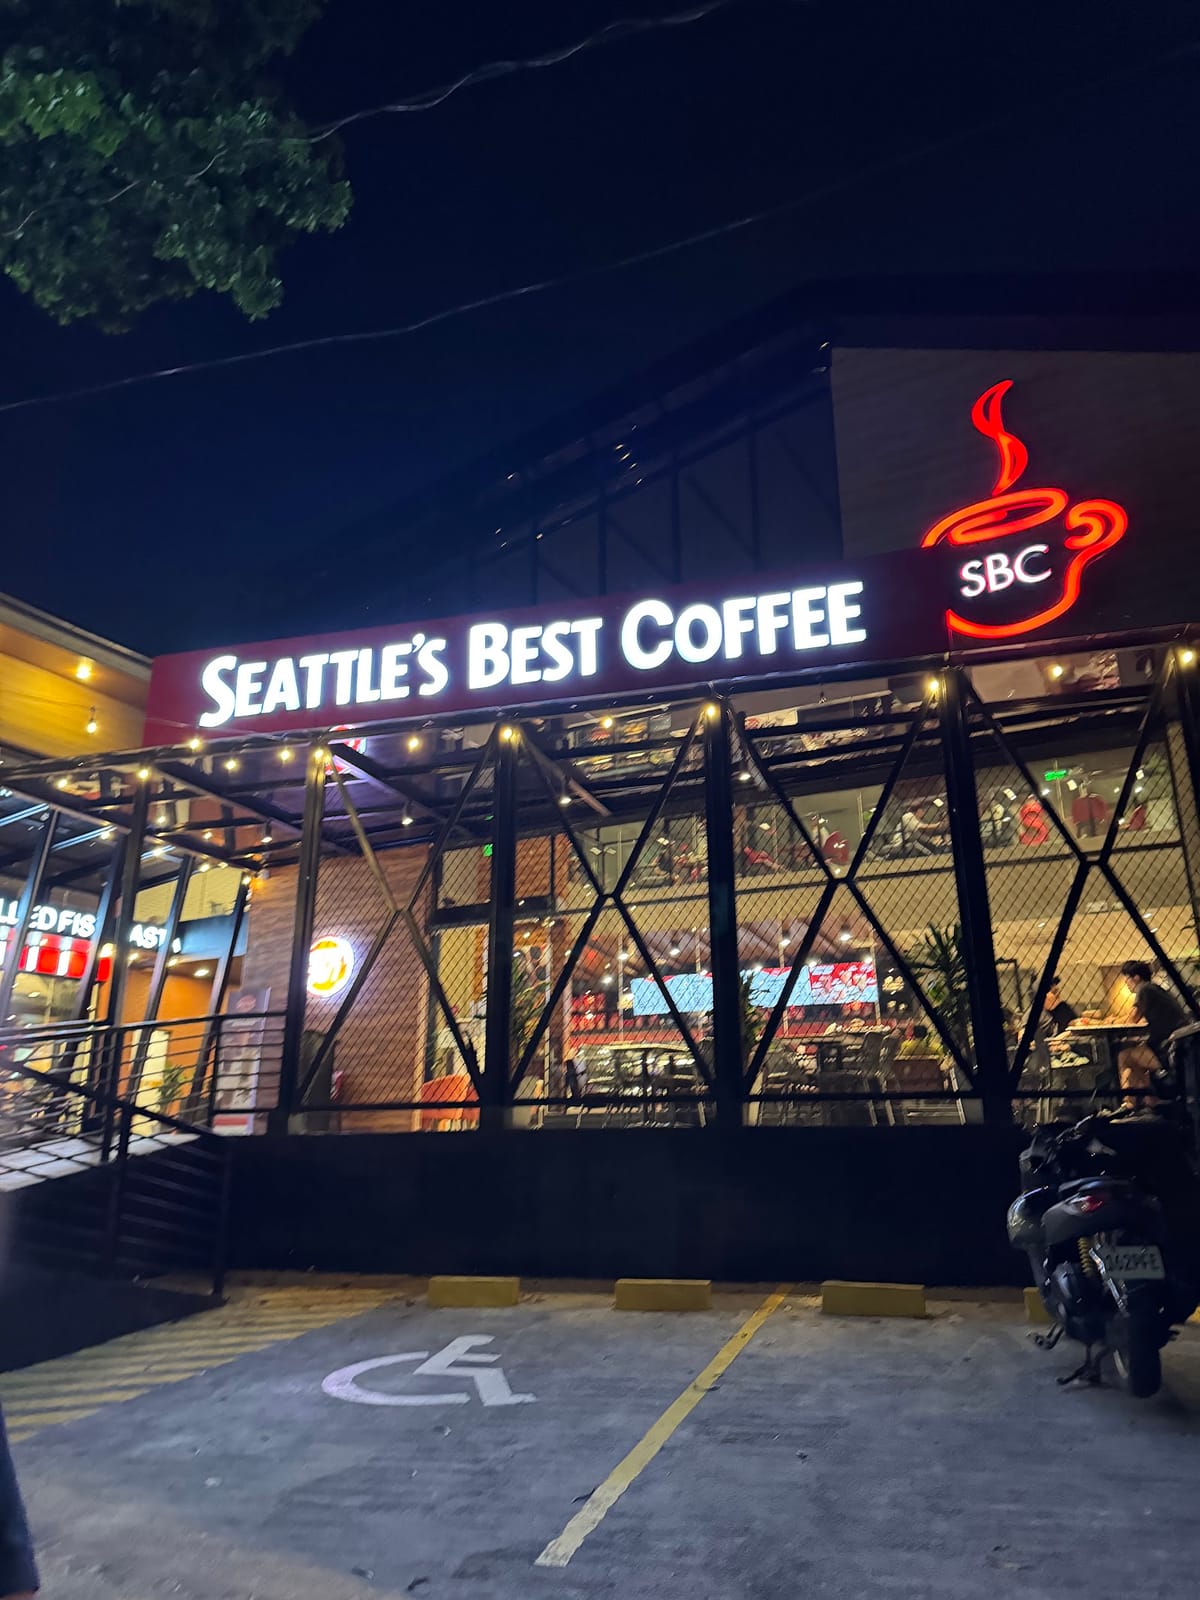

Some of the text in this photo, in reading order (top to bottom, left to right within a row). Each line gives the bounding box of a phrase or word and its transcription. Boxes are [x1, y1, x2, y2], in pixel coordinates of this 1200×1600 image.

[960, 543, 1053, 598] SBC
[198, 580, 868, 729] SEATTLE'S BEST COFFEE
[129, 923, 182, 953] AST
